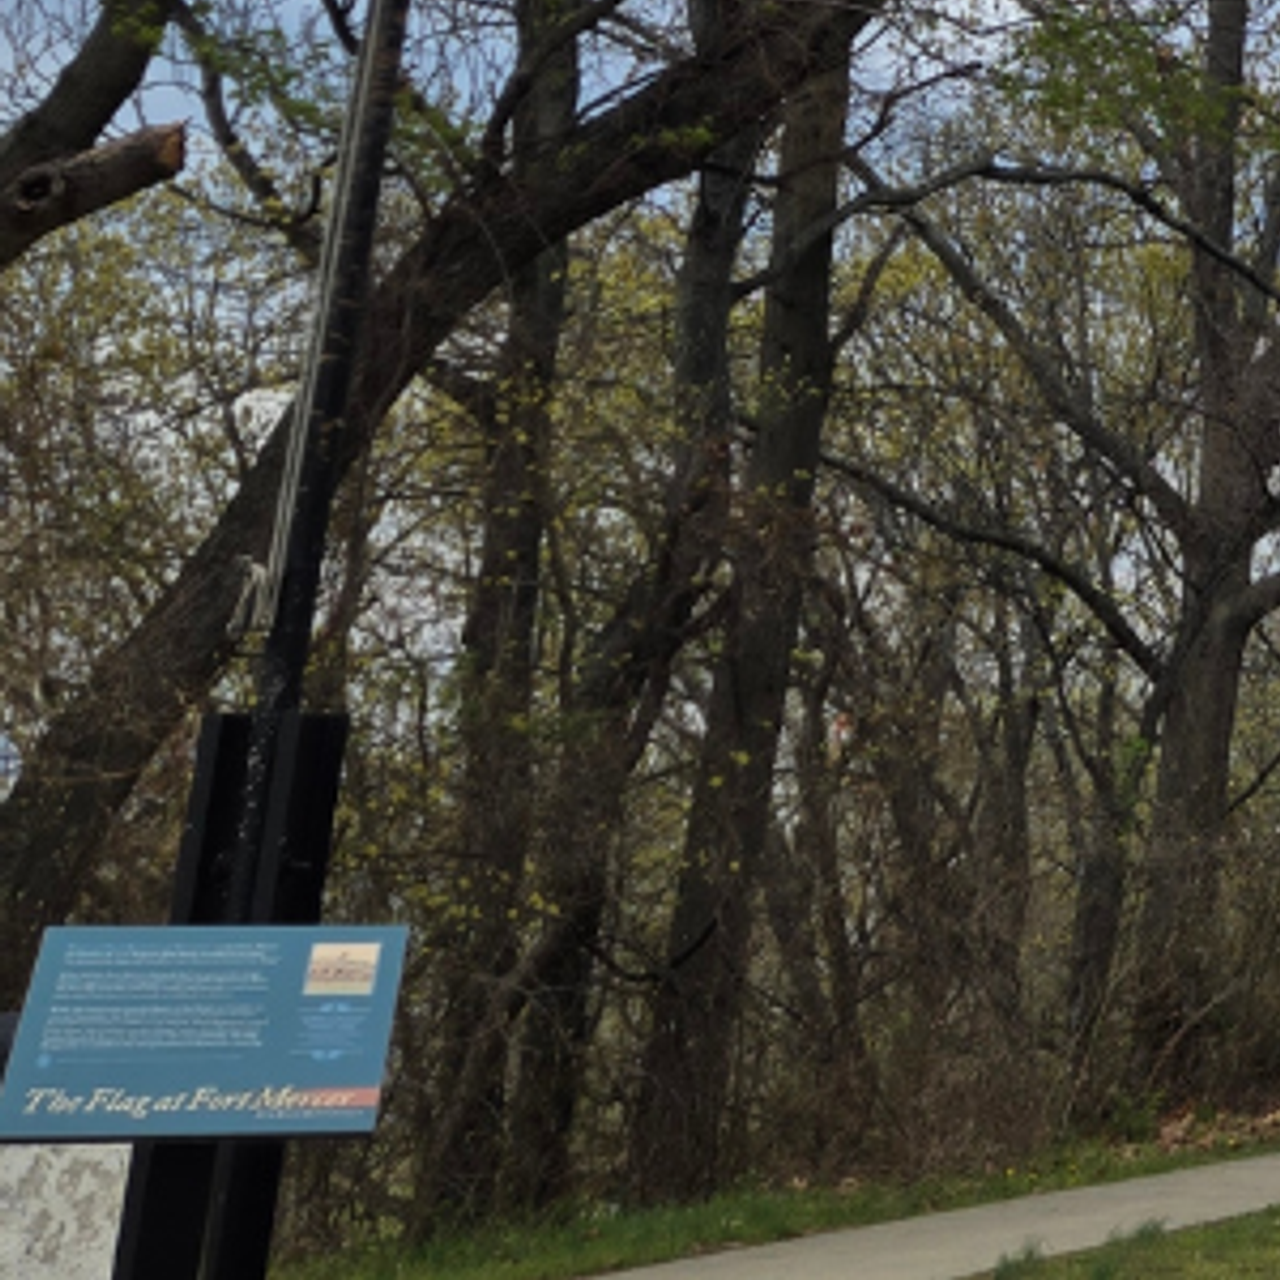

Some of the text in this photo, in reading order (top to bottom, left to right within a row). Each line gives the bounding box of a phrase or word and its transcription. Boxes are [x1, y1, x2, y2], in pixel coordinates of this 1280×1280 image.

[22, 1086, 84, 1115] The
[83, 1086, 151, 1120] Flag
[152, 1092, 188, 1112] at
[184, 1084, 253, 1112] Fort
